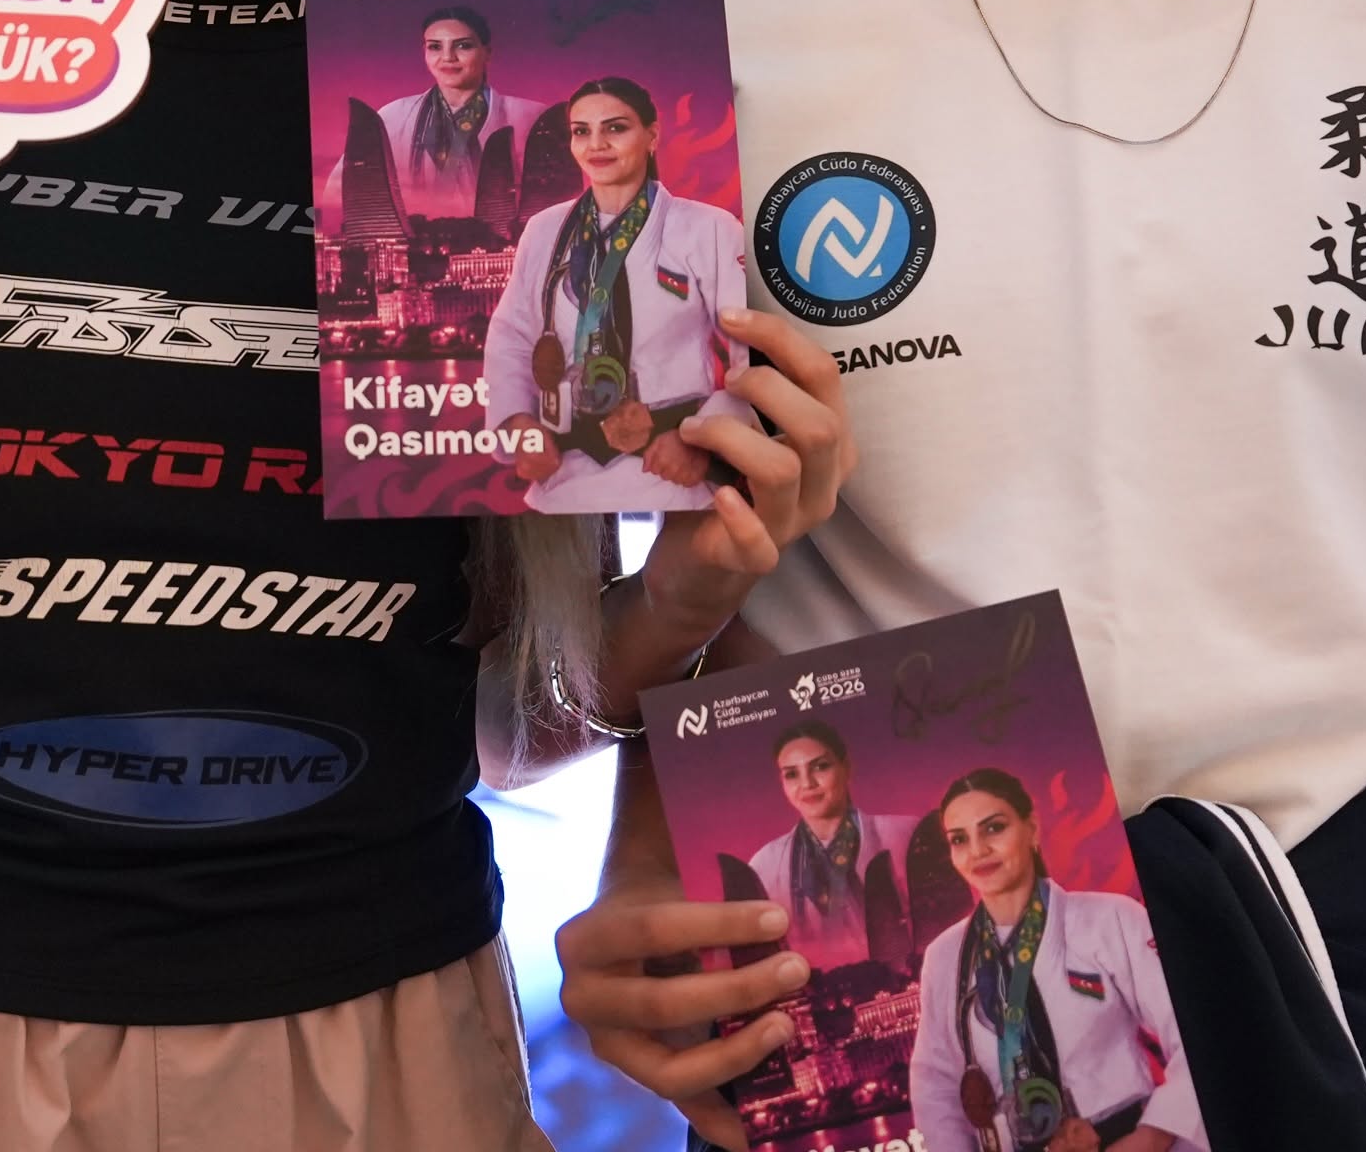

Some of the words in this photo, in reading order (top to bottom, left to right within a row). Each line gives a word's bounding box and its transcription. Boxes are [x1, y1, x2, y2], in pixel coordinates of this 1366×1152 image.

[819, 157, 857, 172] Cüdo
[861, 159, 924, 216] Federasiyası
[768, 266, 825, 318] Azerbaijan
[832, 306, 867, 319] Judo
[871, 246, 926, 311] Federation
[344, 375, 490, 416] Kifayət
[344, 423, 544, 460] Qasımova
[242, 447, 324, 496] R
[819, 678, 865, 700] 2026
[199, 754, 340, 785] DRIVE
